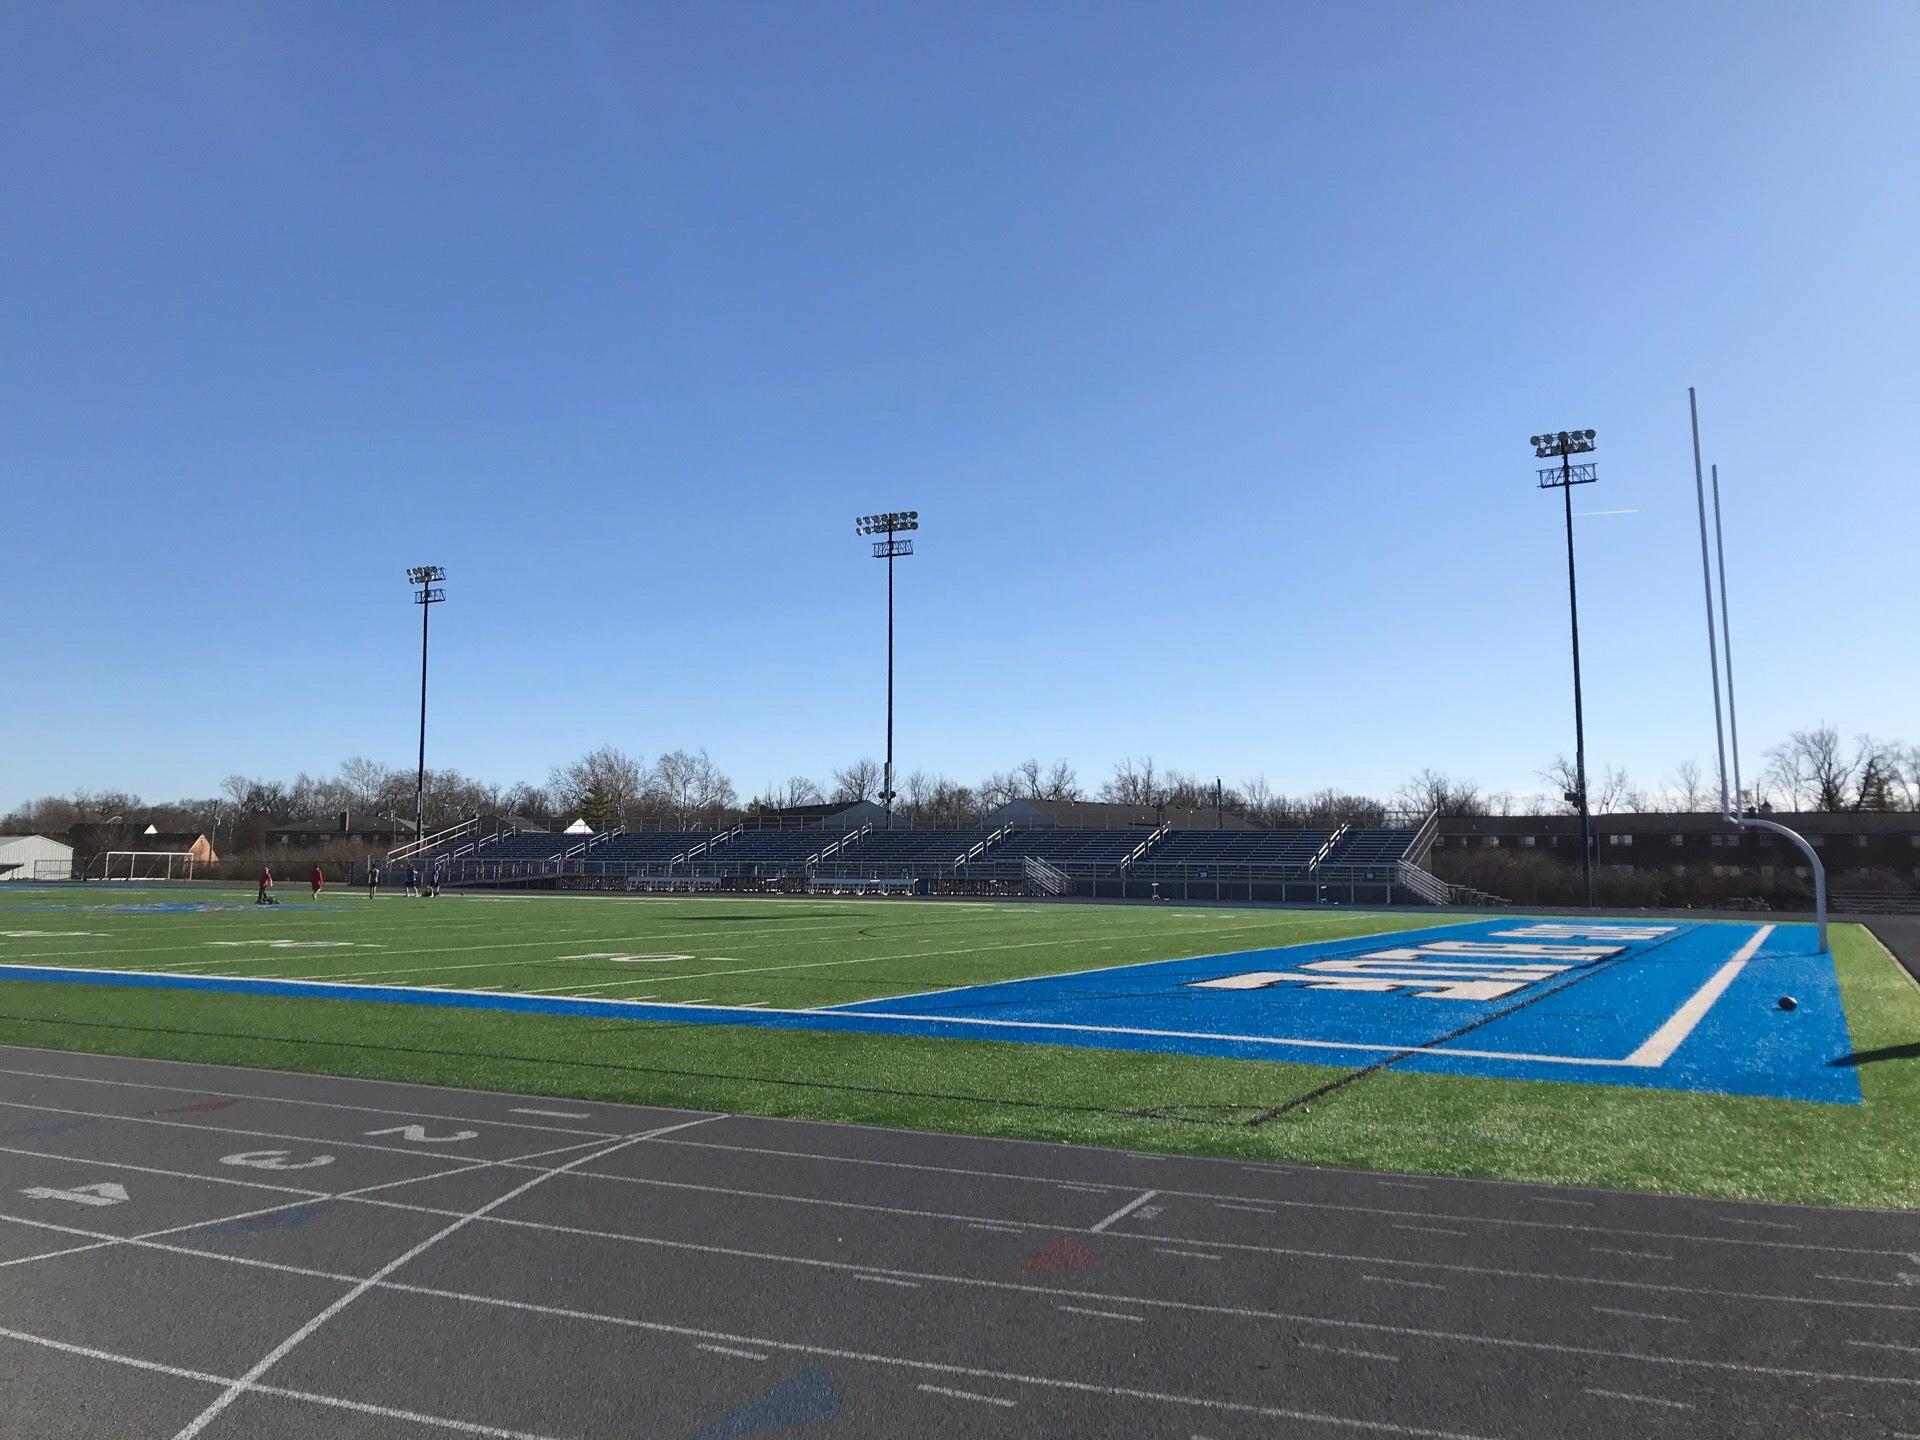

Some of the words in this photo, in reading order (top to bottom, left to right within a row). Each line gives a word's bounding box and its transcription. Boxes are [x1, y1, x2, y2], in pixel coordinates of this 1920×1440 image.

[1187, 941, 1627, 1001] BLUE
[364, 1124, 479, 1143] 2
[219, 1150, 336, 1170] 3
[18, 1182, 131, 1207] 4
